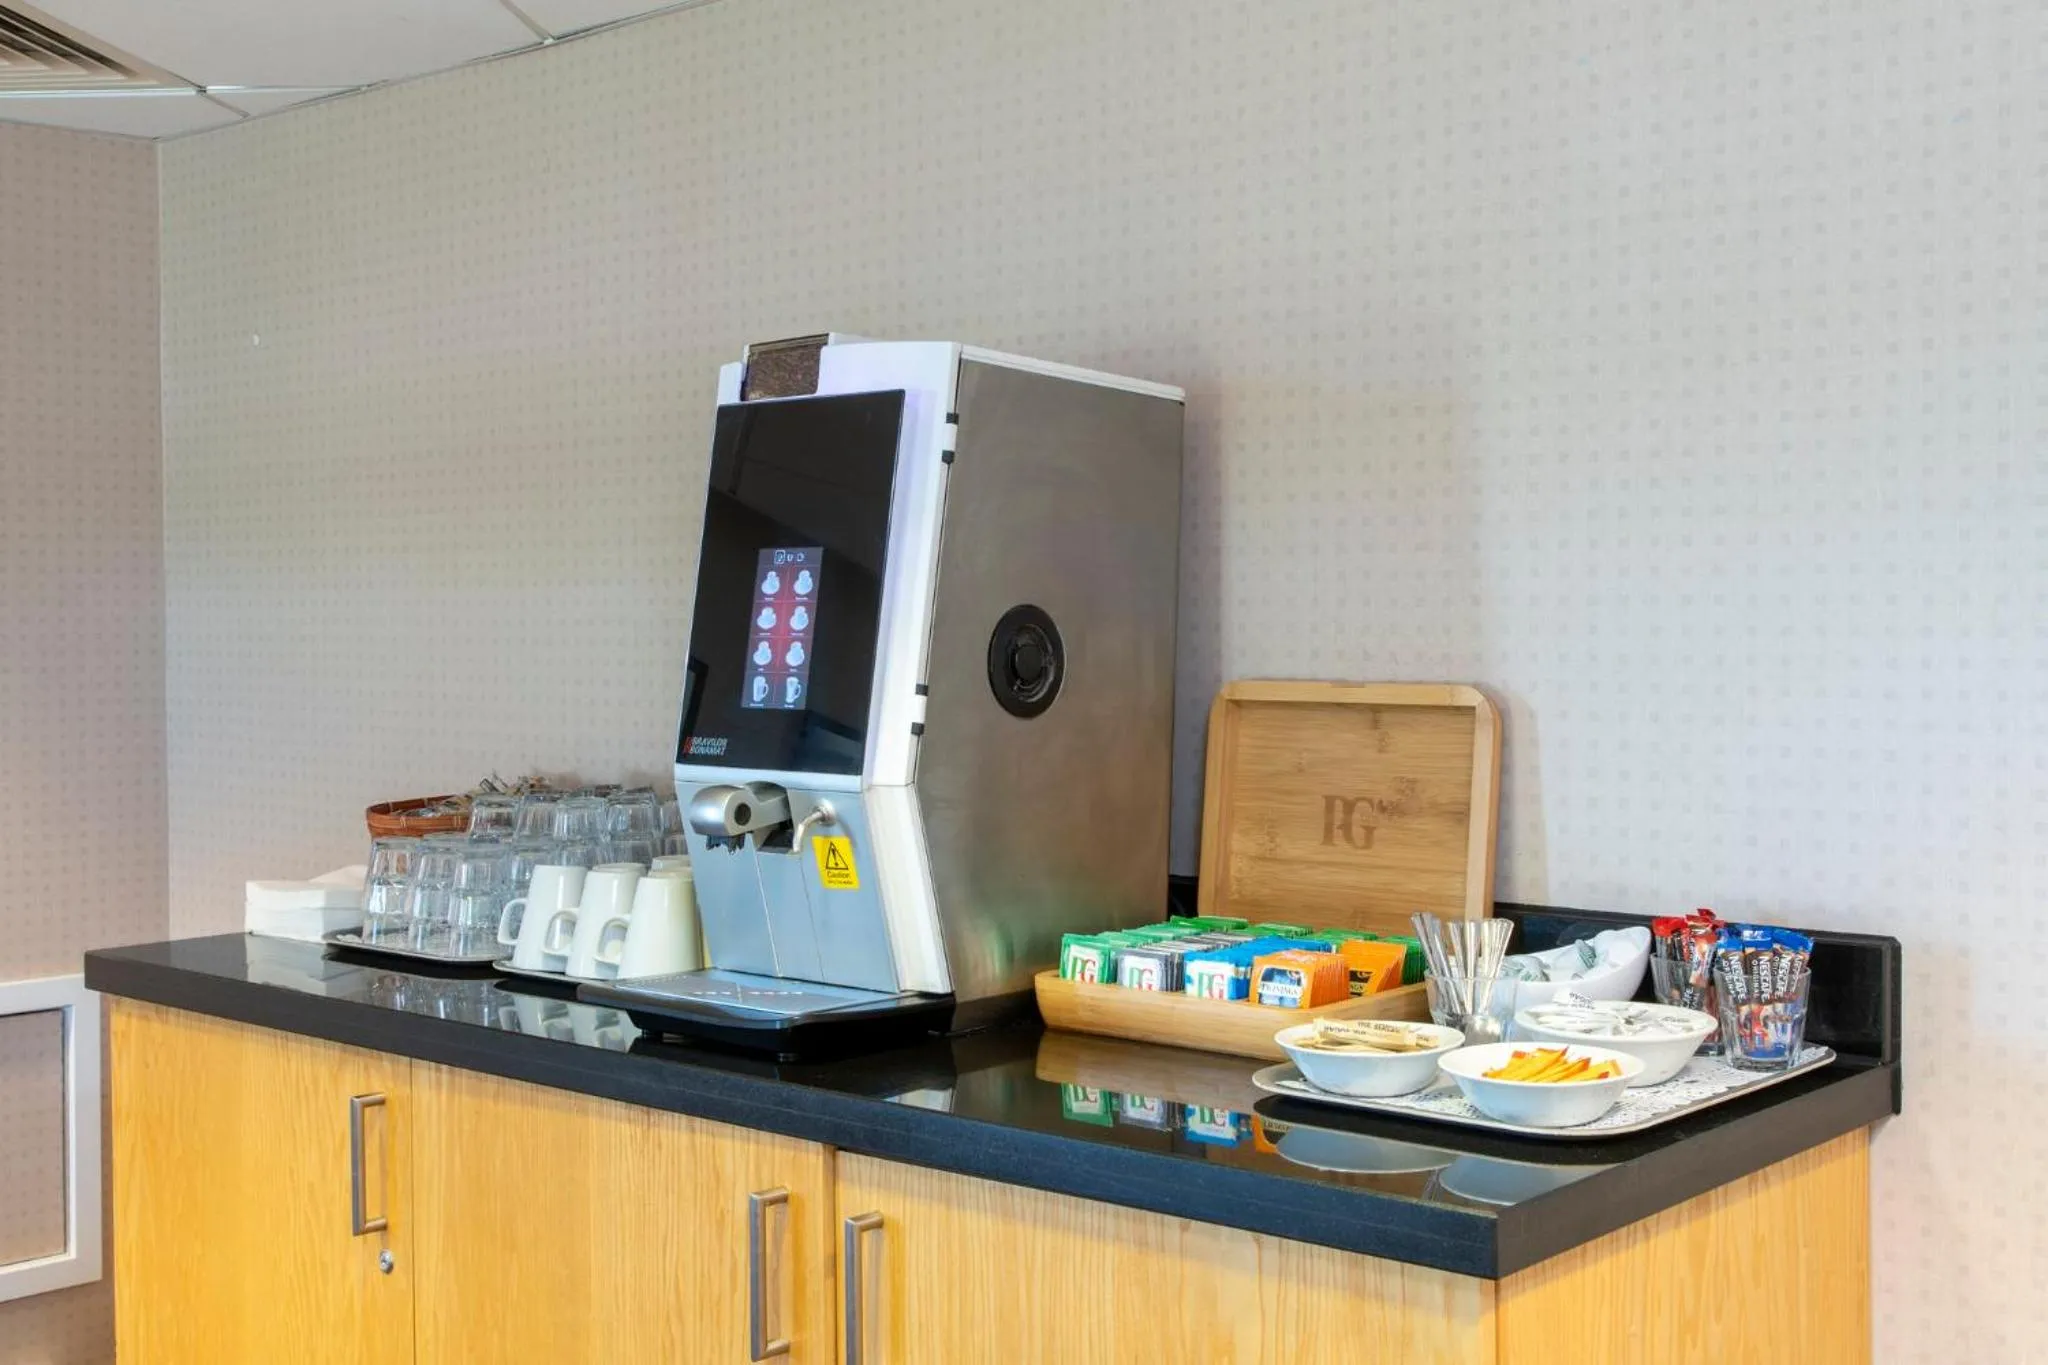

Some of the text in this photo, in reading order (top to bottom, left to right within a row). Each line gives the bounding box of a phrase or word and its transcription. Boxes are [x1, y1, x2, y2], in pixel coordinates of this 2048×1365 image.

[1321, 795, 1378, 850] PG
[1071, 956, 1098, 984] PG
[1128, 966, 1155, 991] PG
[1197, 971, 1225, 1000] PG
